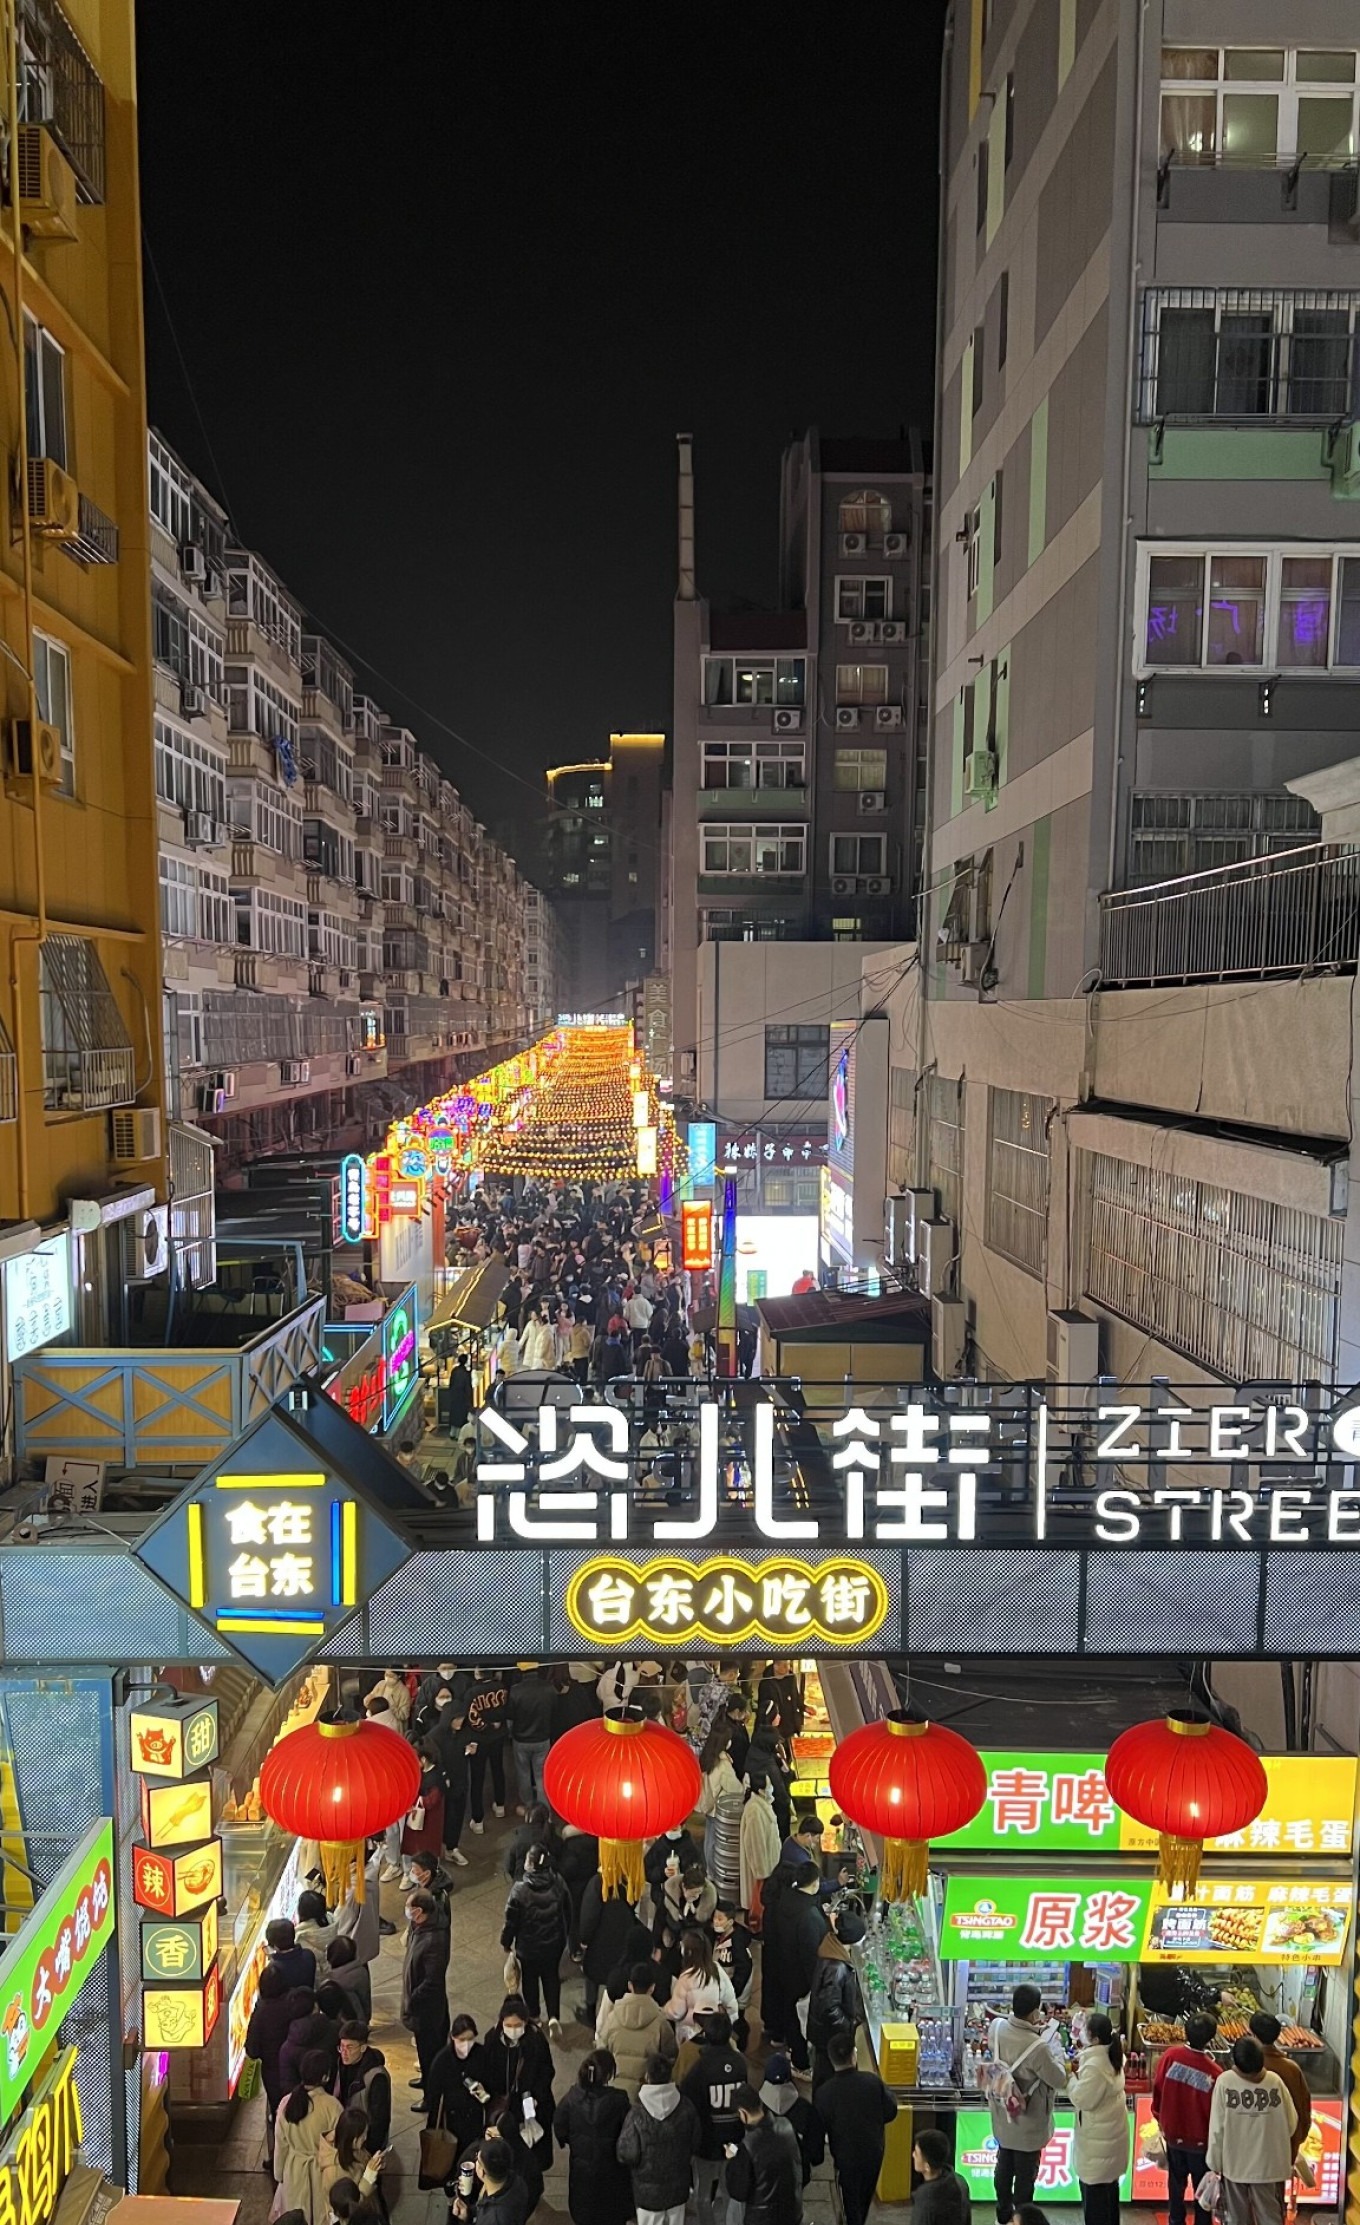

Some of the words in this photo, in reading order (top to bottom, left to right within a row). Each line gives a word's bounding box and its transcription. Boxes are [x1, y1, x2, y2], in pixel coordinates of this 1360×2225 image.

[1097, 1405, 1309, 1457] ZIER
[477, 1403, 991, 1540] 恣儿街
[225, 1500, 313, 1544] 食在
[228, 1552, 314, 1598] 台东
[588, 1574, 870, 1624] 台东小吃街
[191, 1712, 211, 1757] 甜
[989, 1769, 1114, 1834] 青啤
[142, 1863, 165, 1900] 辣
[955, 1915, 1013, 1927] TSINGTAO
[1023, 1894, 1138, 1948] 原浆
[155, 1936, 188, 1968] 香
